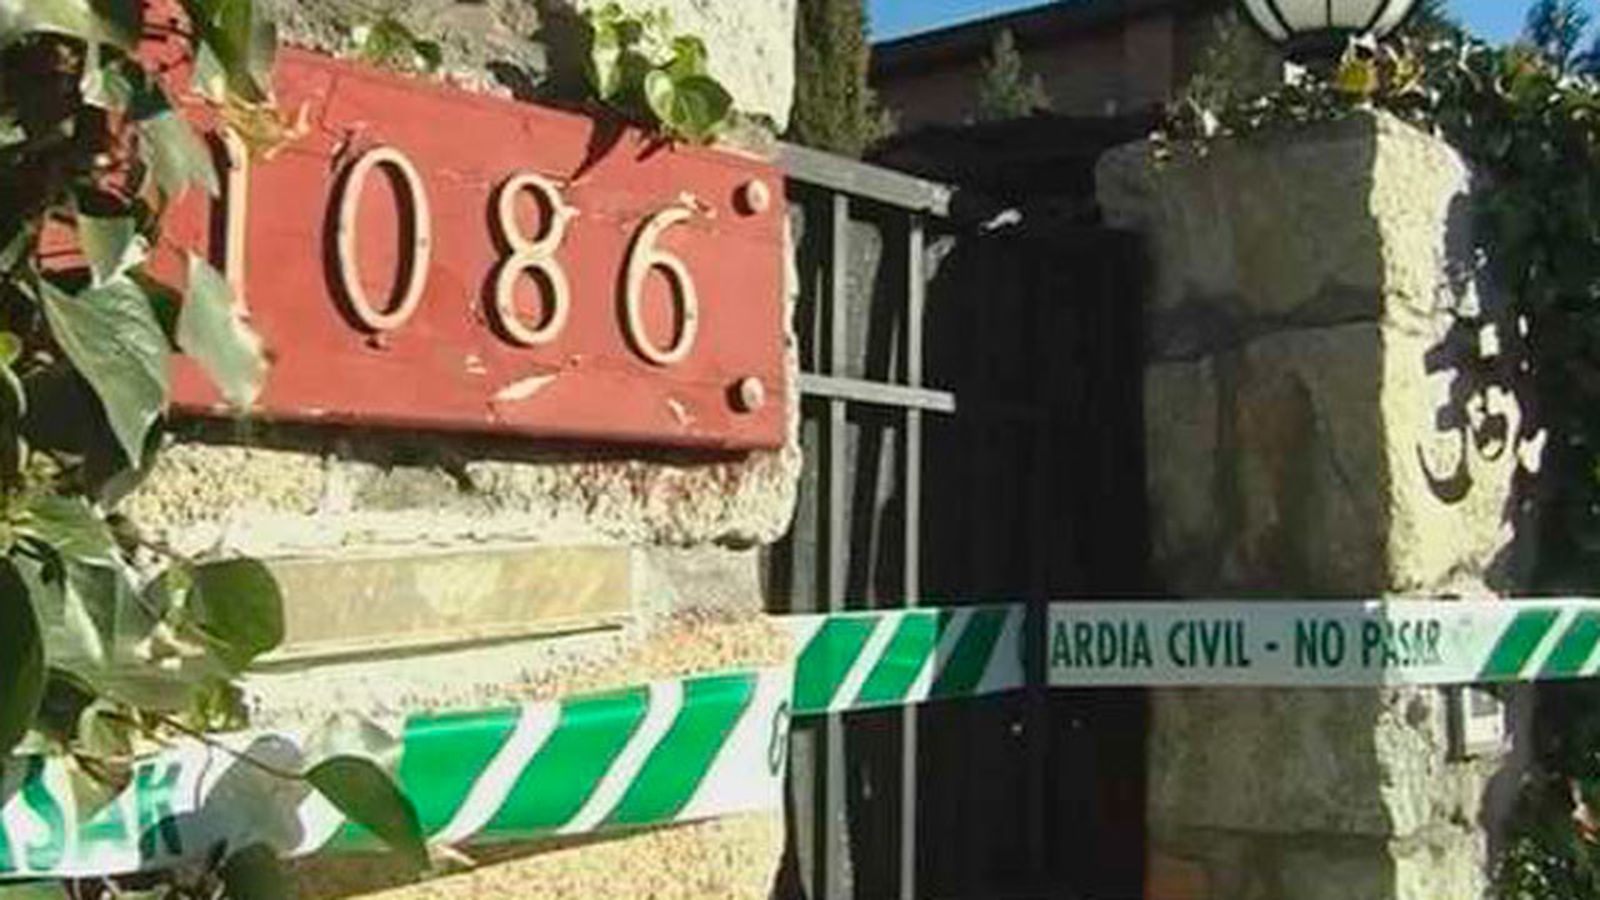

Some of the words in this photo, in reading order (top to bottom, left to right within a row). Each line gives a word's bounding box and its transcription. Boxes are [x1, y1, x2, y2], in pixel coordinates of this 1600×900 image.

[221, 126, 699, 364] 1086
[1168, 620, 1251, 667] CIVIL
[1295, 620, 1346, 667] NO
[1361, 619, 1442, 669] PASAR
